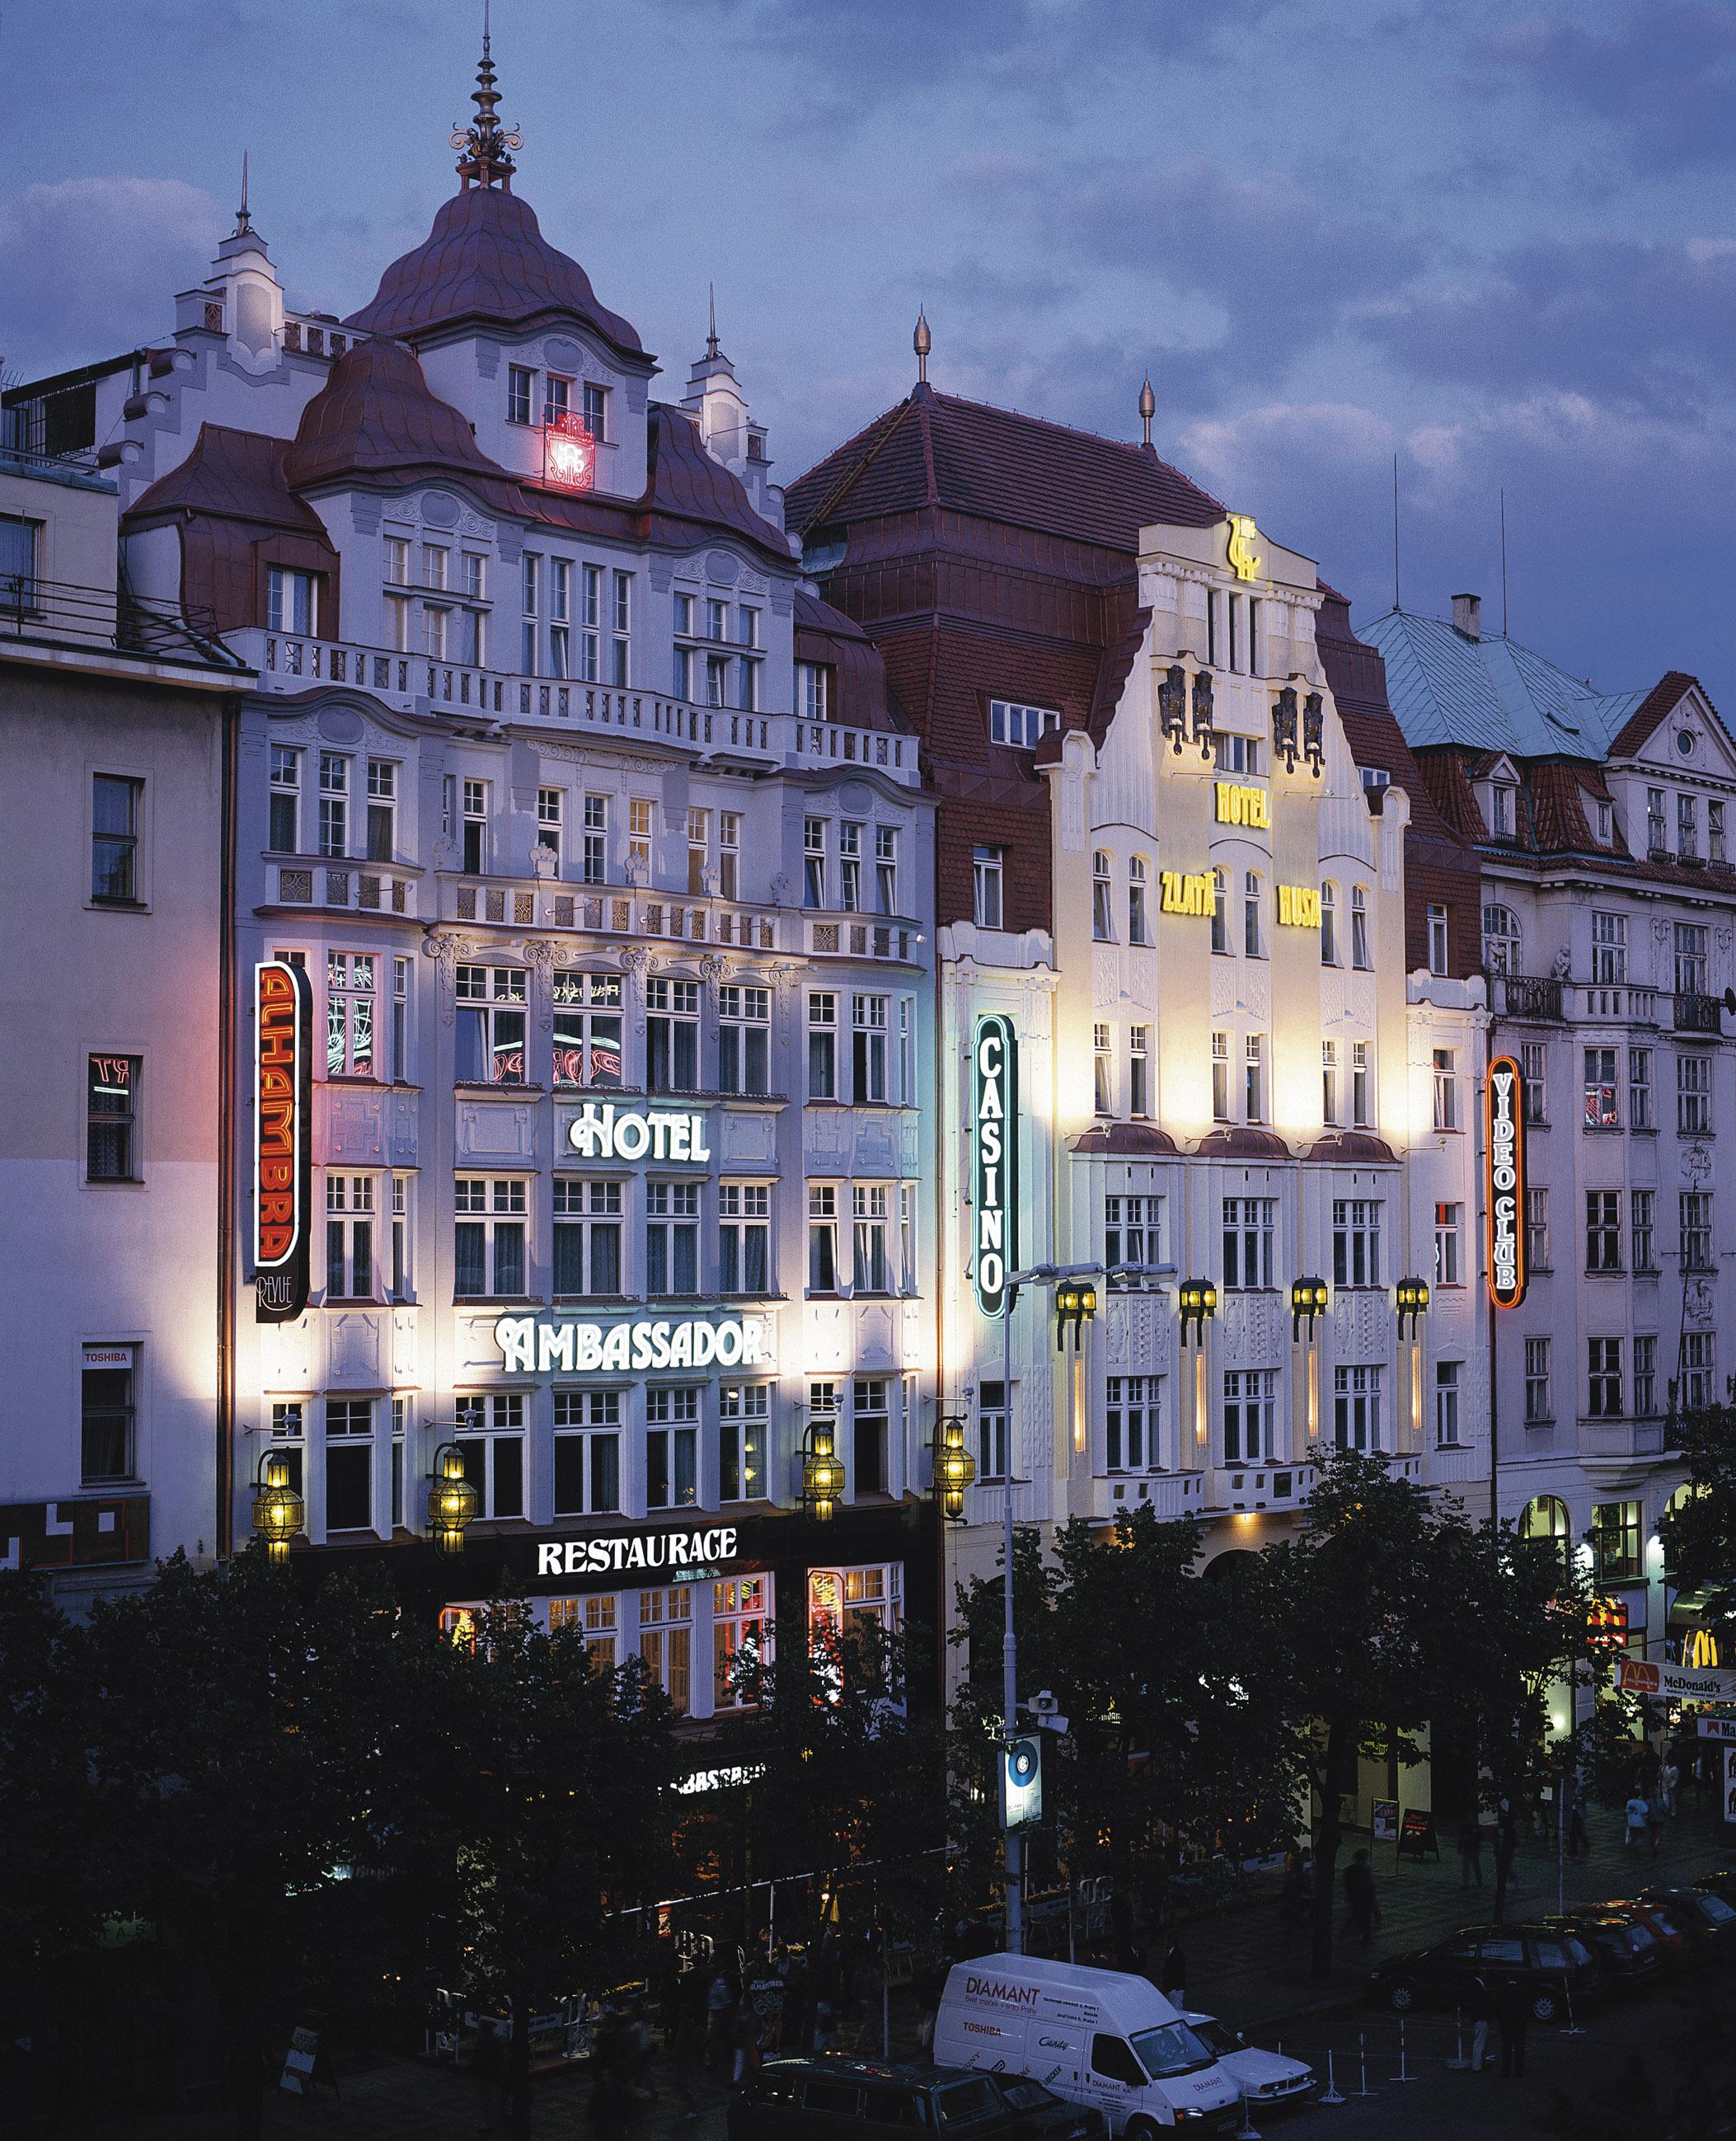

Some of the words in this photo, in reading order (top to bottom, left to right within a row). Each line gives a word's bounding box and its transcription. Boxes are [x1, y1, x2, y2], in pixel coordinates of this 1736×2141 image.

[1215, 782, 1270, 829] HOTEL
[1277, 885, 1322, 927] HUSA
[260, 968, 295, 1259] ALHAMBRA
[570, 1103, 711, 1162] HOTEL
[1493, 1073, 1516, 1190] VIDEO
[978, 1036, 1004, 1294] CASINO
[1494, 1196, 1516, 1289] CLUB
[256, 1276, 293, 1312] REVUE
[86, 1353, 127, 1363] TOSHIBA
[495, 1317, 763, 1373] AMBASSADOR
[537, 1528, 738, 1575] RESTAURACE
[1663, 1675, 1721, 1693] McDonald's
[965, 1977, 1040, 2006] DIAMANT
[963, 2021, 1002, 2037] TOSHIBA
[1039, 2036, 1068, 2051] Candy
[1093, 2080, 1121, 2092] DIAMANT
[1194, 2077, 1223, 2092] DIAMANT
